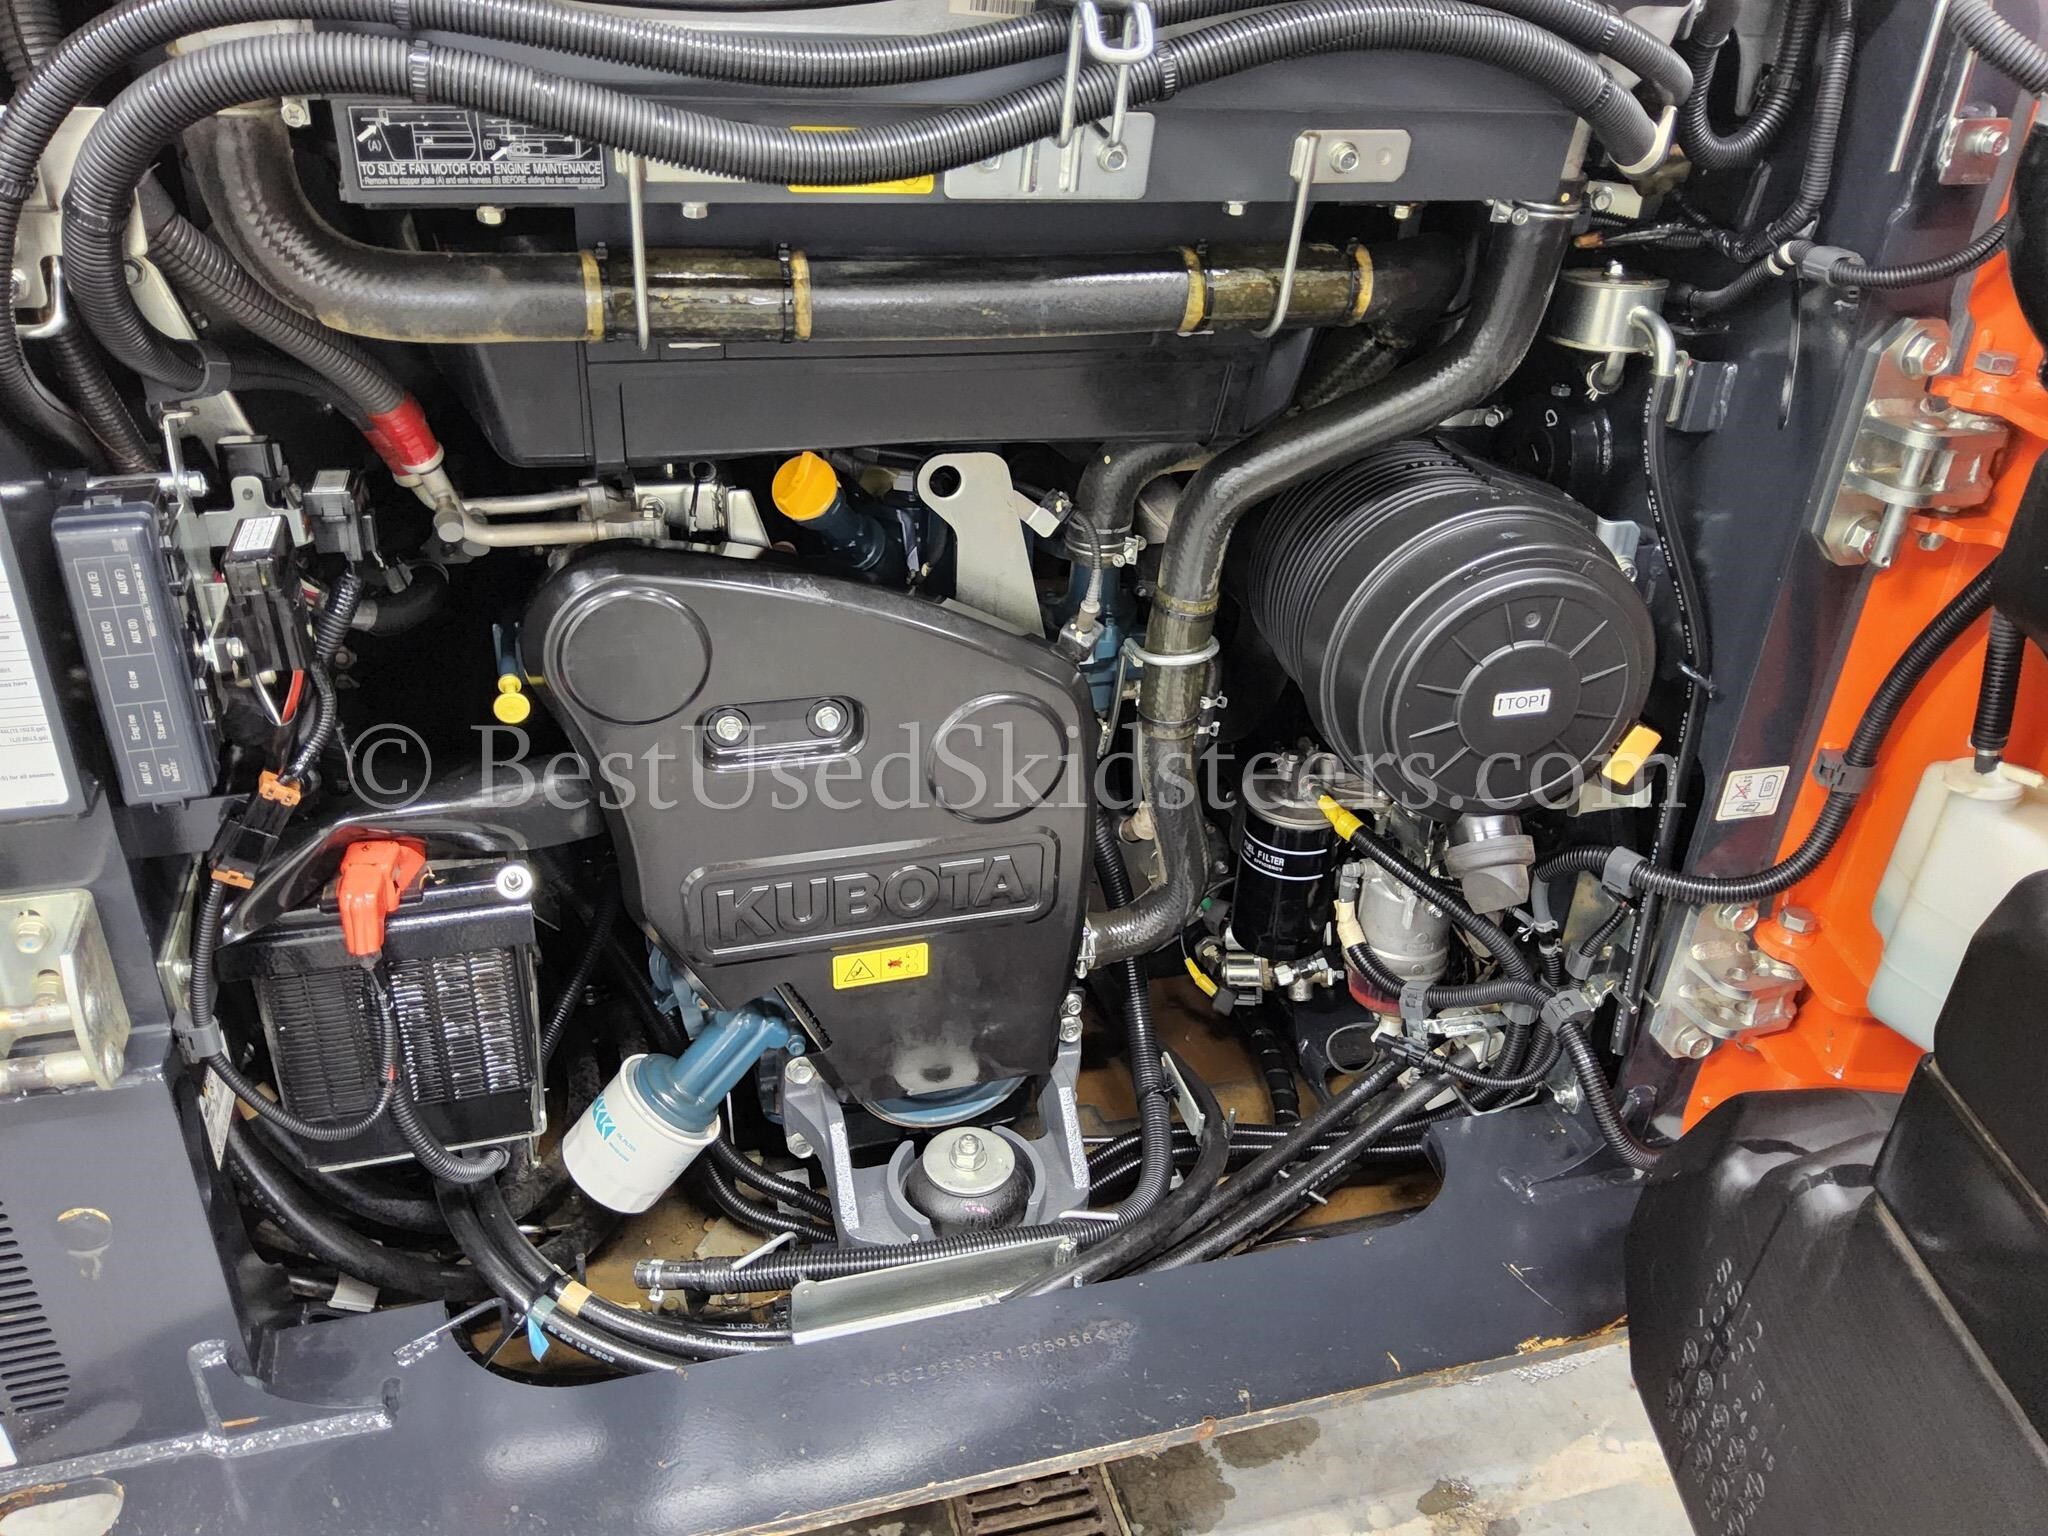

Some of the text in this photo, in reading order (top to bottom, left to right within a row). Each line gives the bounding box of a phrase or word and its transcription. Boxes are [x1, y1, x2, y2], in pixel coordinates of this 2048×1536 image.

[368, 140, 381, 152] (A)
[483, 139, 496, 151] (B)
[361, 162, 601, 175] TO SLIDE FAN MOTOR FOR ENGINE MAINTENANCE
[502, 175, 527, 184] BEFORE
[128, 671, 139, 689] Glow
[1506, 696, 1539, 710] TOP
[128, 714, 141, 741] Engine
[153, 710, 167, 740] Starter
[160, 764, 171, 777] CCV
[1257, 850, 1285, 866] FILTER
[716, 854, 1029, 942] KUBOTA
